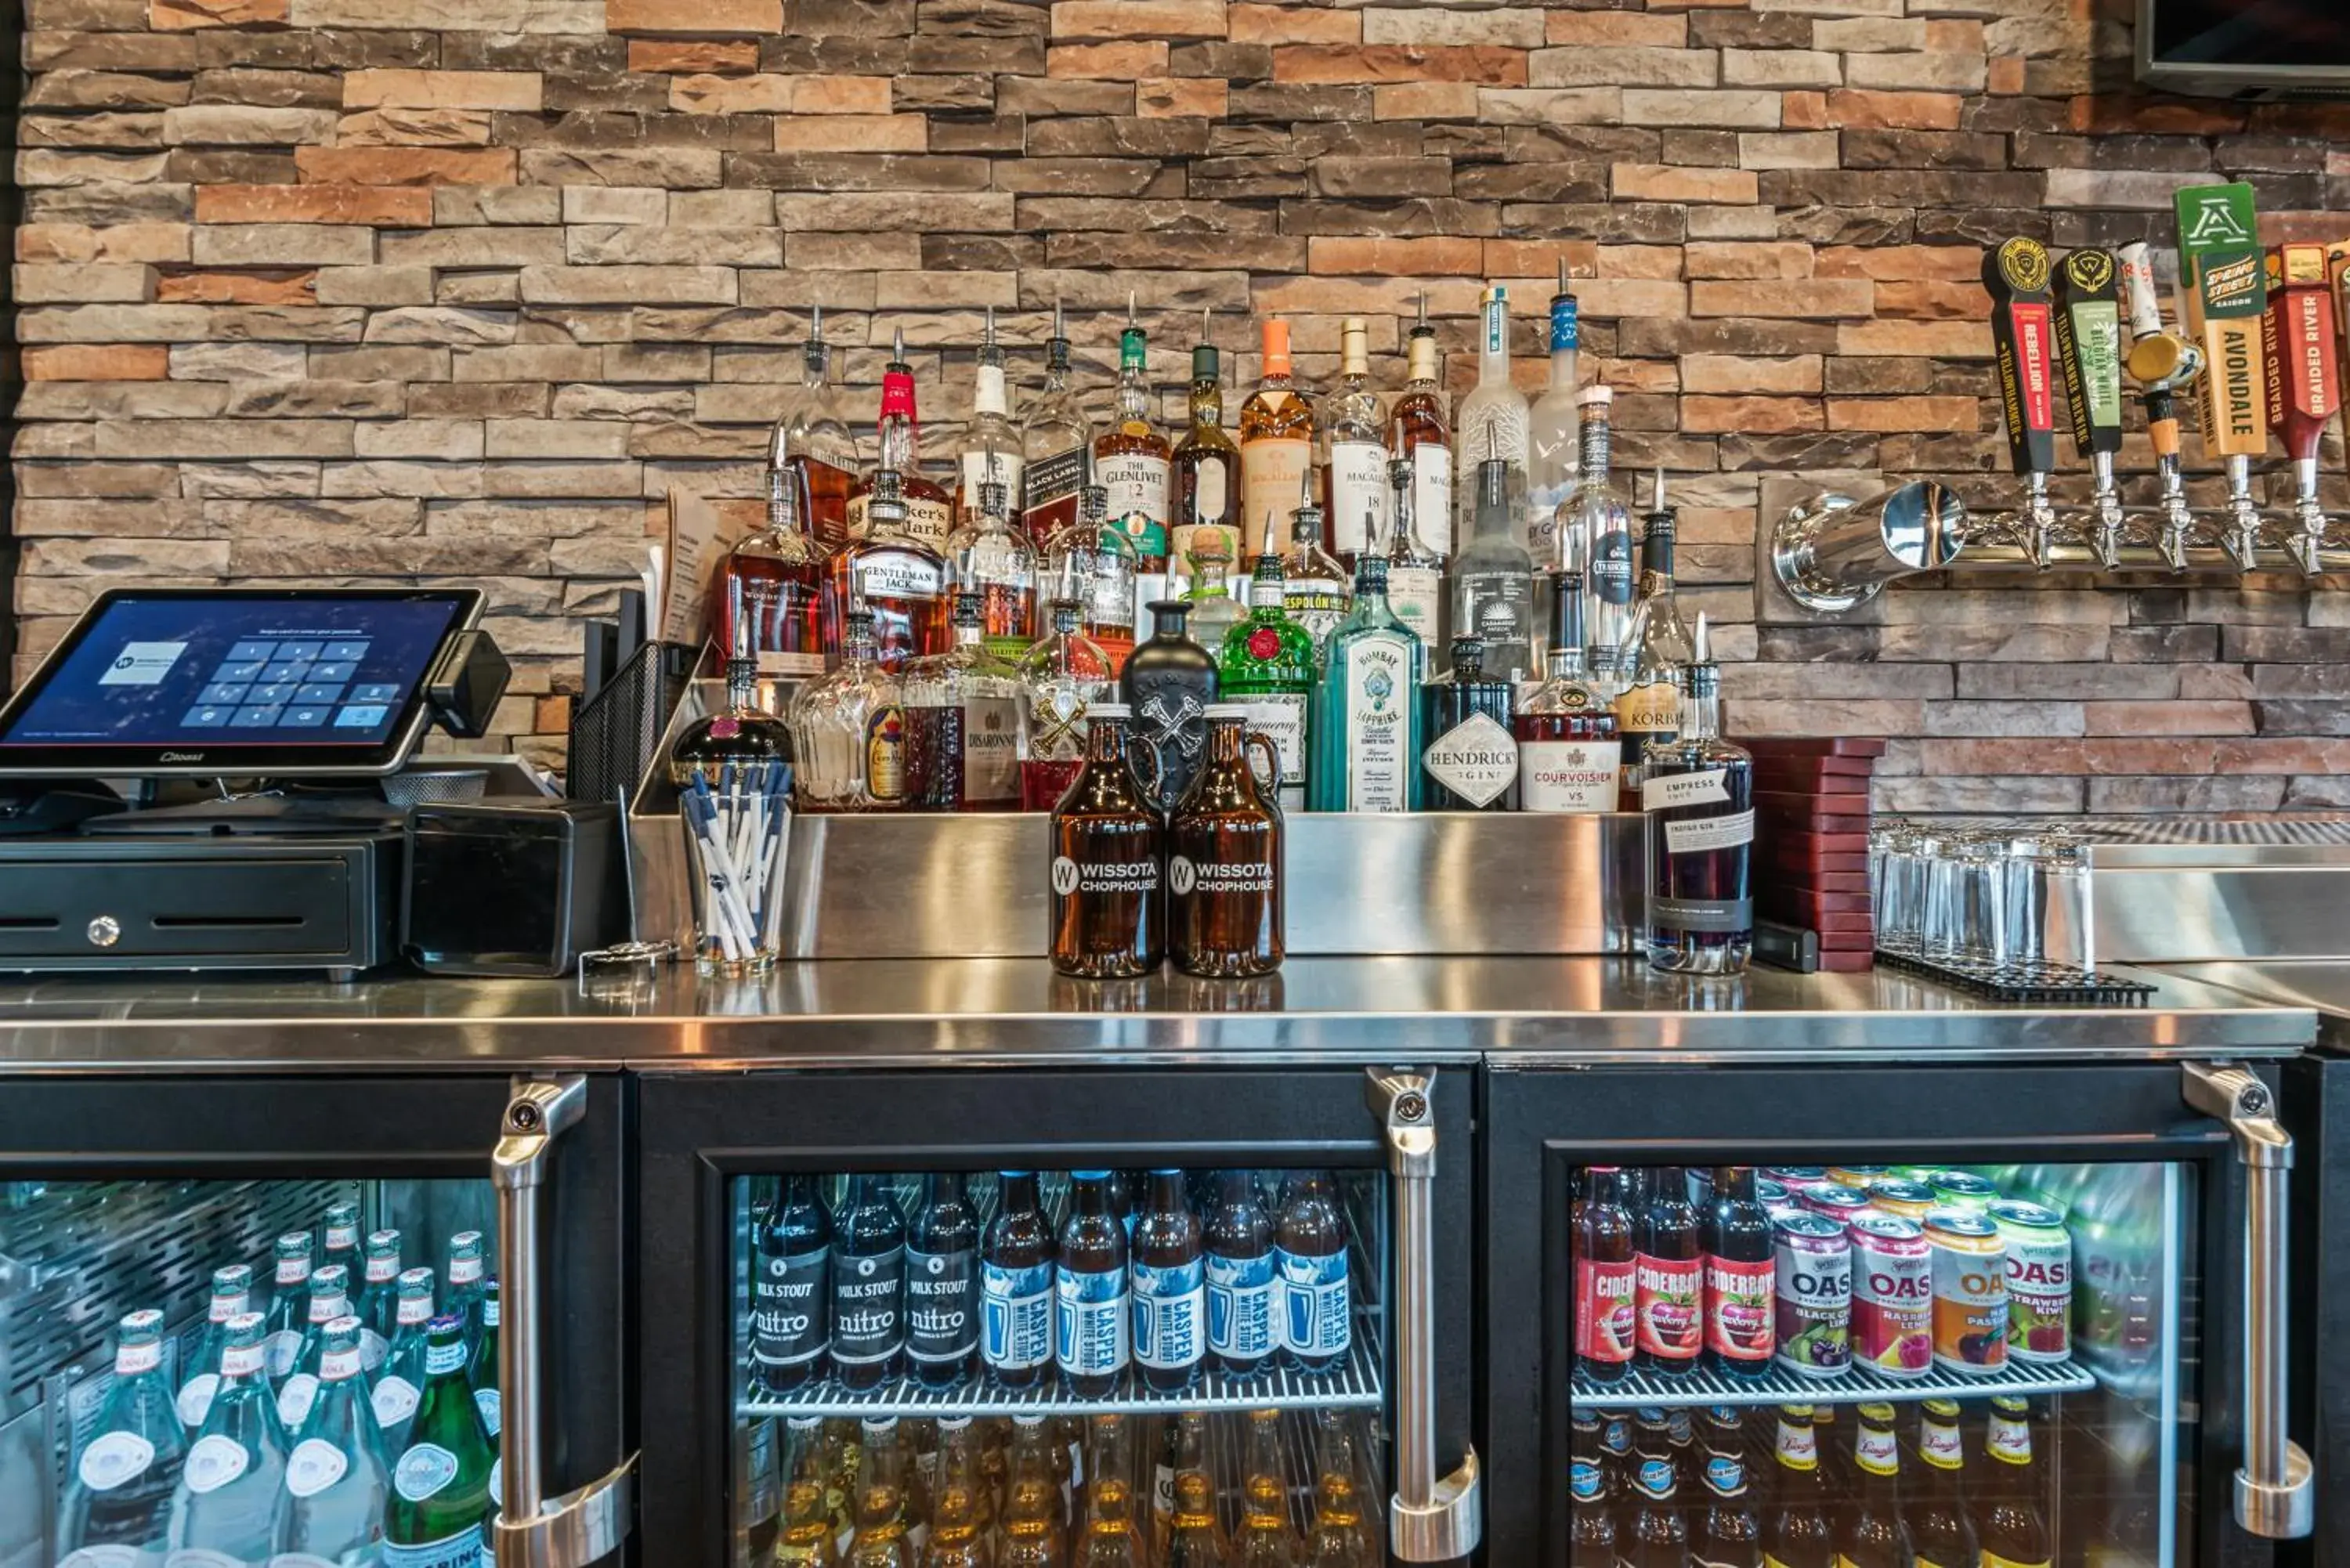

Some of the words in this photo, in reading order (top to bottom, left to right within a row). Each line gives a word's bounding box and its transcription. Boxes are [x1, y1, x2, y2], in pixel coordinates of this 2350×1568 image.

[2303, 296, 2319, 341] RIVER
[2024, 323, 2044, 392] REBELLION
[2090, 330, 2107, 370] BELGIAN
[2056, 313, 2080, 394] YELLOWHAMMER
[2070, 394, 2091, 444] BREWING
[2096, 375, 2113, 406] WHITE
[2224, 331, 2253, 435] AVONDALE
[2268, 356, 2283, 424] BRAIDED
[2307, 346, 2325, 414] BRAIDED
[2001, 349, 2022, 435] YELLOWHAMMER
[1105, 471, 1163, 486] GLENLIVET
[1127, 461, 1144, 471] THE
[907, 506, 946, 522] ker's
[1367, 496, 1380, 509] 18
[906, 521, 945, 537] ark
[865, 565, 933, 582] GENTLEMAN
[885, 578, 914, 589] JACK
[1358, 650, 1399, 670] BOMBAY
[1355, 710, 1403, 726] SAPPHIRE
[1466, 771, 1495, 780] GIN
[1535, 772, 1611, 782] COURVOISIER
[1665, 779, 1715, 792] EMPRESS
[1568, 792, 1584, 800] VS
[1080, 862, 1157, 878] WISSOTA
[1196, 862, 1274, 878] WISSOTA
[1080, 879, 1157, 891] CHOPHOUSE
[1196, 879, 1274, 891] CHOPHOUSE
[777, 1282, 815, 1298] STOUT
[838, 1284, 863, 1299] MILK
[864, 1279, 899, 1297] STOUT
[909, 1280, 933, 1295] MILK
[933, 1280, 969, 1295] STOUT
[1961, 1272, 2004, 1295] OA
[1016, 1303, 1029, 1333] WHITE
[1161, 1303, 1173, 1334] WHITE
[1239, 1295, 1251, 1324] WHITE
[1321, 1291, 1333, 1323] WHITE
[1334, 1284, 1347, 1349] CASPER
[1796, 1309, 1835, 1321] BLACK
[757, 1310, 809, 1333] nitro
[838, 1310, 895, 1333] nitro
[910, 1308, 965, 1333] nitro
[1030, 1298, 1048, 1362] CASPER
[1083, 1310, 1095, 1339] WHITE
[1174, 1299, 1192, 1362] CASPER
[1253, 1290, 1269, 1353] CASPER
[1016, 1335, 1029, 1363] STOUT
[1097, 1306, 1115, 1370] CASPER
[1161, 1335, 1173, 1363] STOUT
[1239, 1324, 1251, 1353] STOUT
[1321, 1324, 1333, 1349] STOUT
[1083, 1340, 1095, 1370] STOUT
